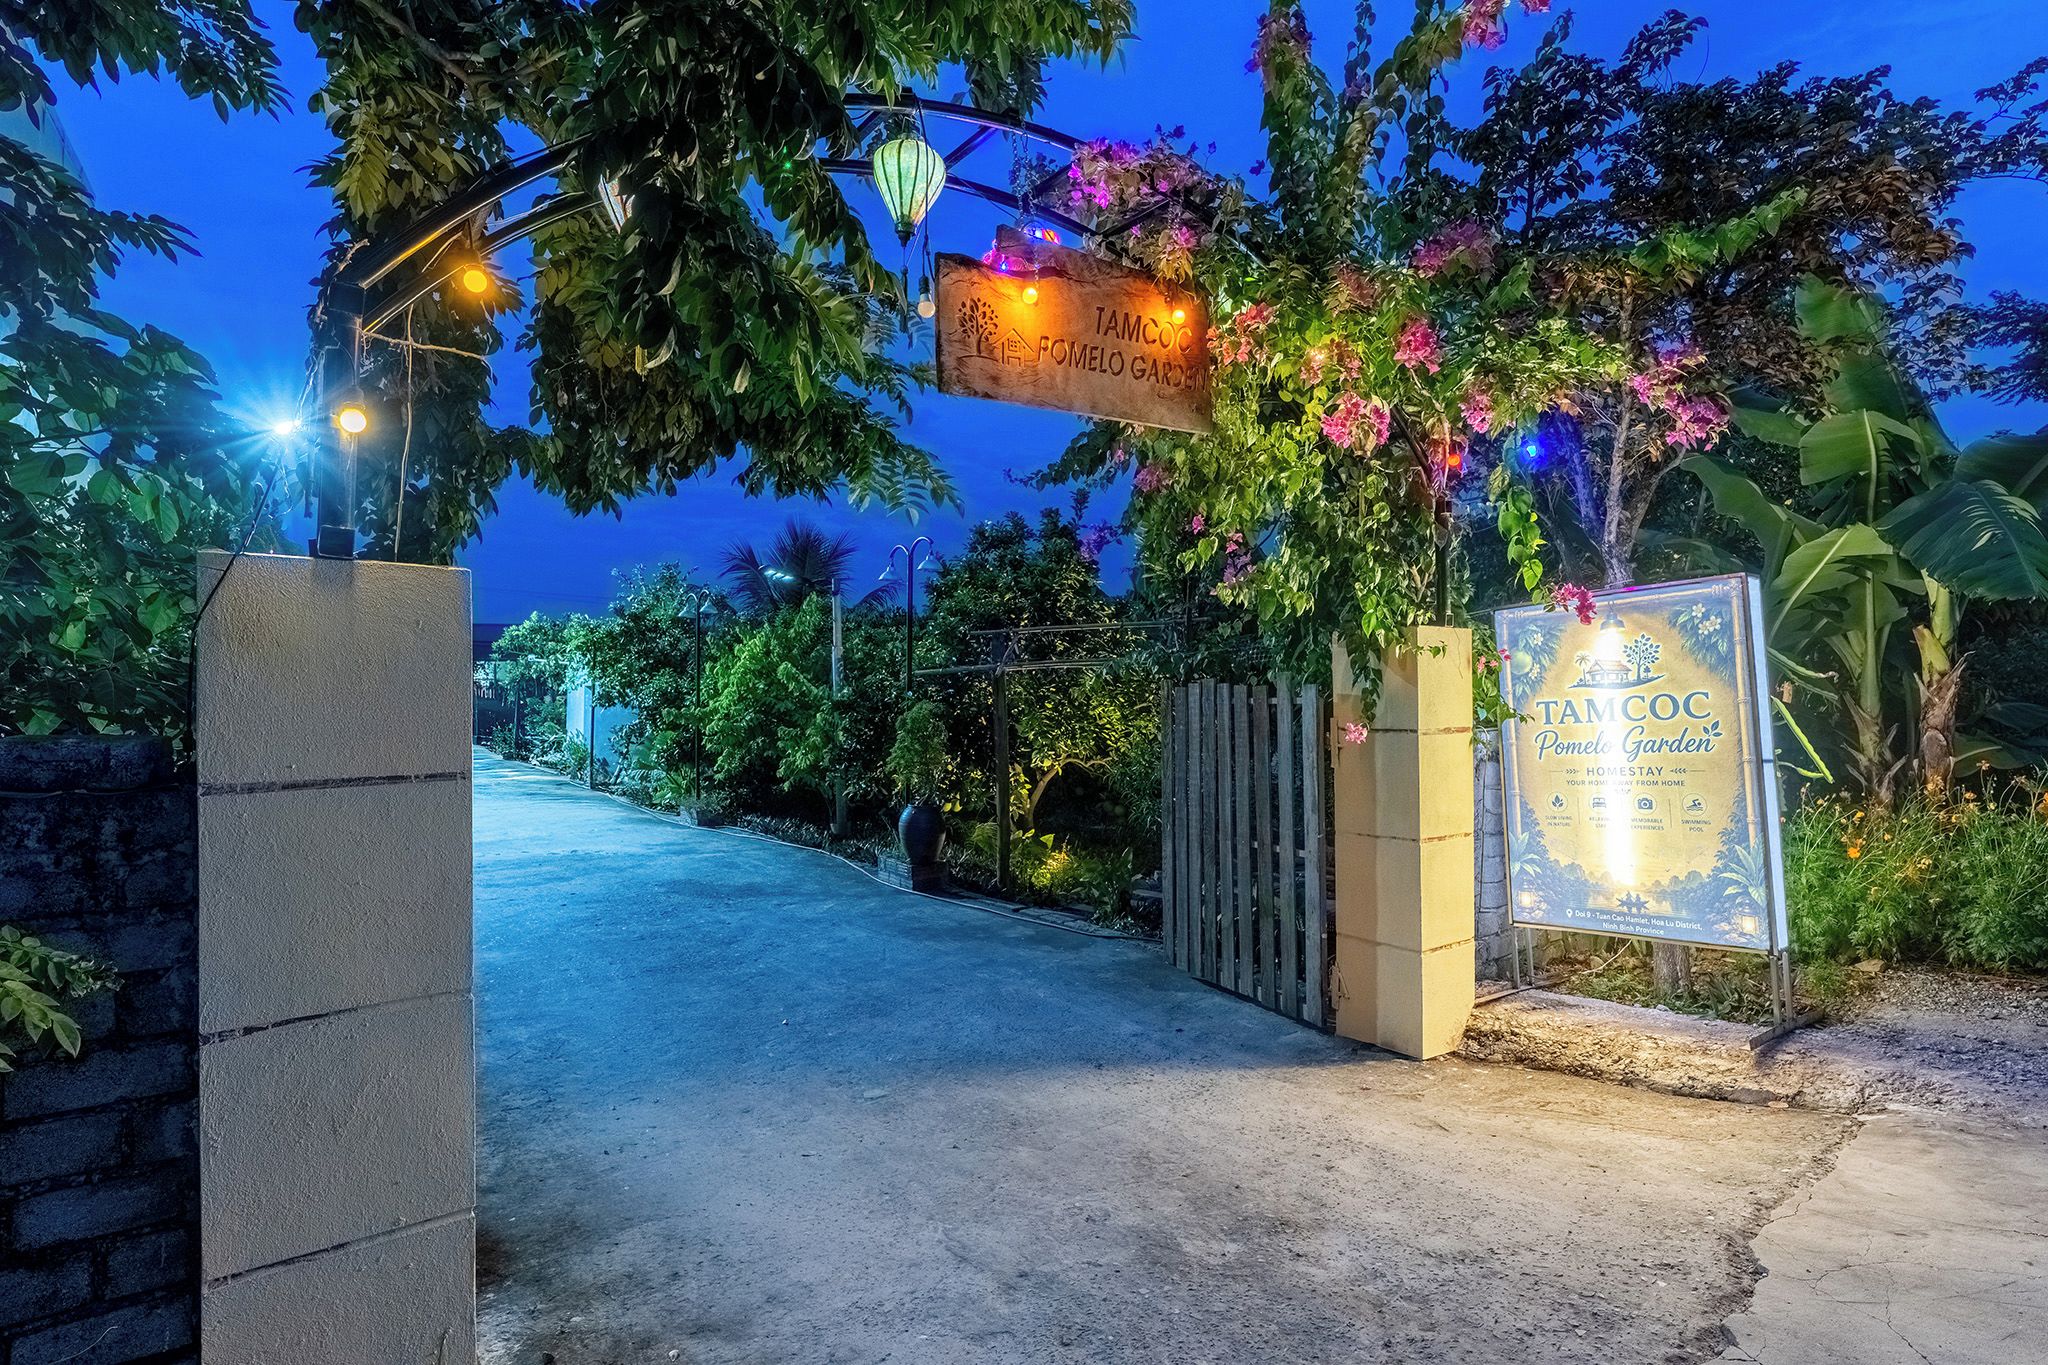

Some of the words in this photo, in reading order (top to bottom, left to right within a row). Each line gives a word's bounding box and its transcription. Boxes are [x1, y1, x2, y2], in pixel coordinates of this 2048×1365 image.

[1095, 305, 1193, 354] TAMCOC
[1037, 335, 1125, 377] POMELO
[1130, 354, 1209, 393] GARDEN
[1536, 691, 1712, 725] TAMCOC
[1534, 729, 1613, 761] Pomelo
[1622, 725, 1717, 763] Garden
[1586, 766, 1664, 776] HOMESTAY
[1596, 912, 1611, 920] Tuan
[1612, 913, 1625, 922] Cao
[1625, 916, 1650, 925] Hamlet,
[1651, 918, 1665, 926] Hoa
[1675, 921, 1704, 931] District,
[1602, 922, 1618, 930] Ninh
[1635, 926, 1665, 936] Province
